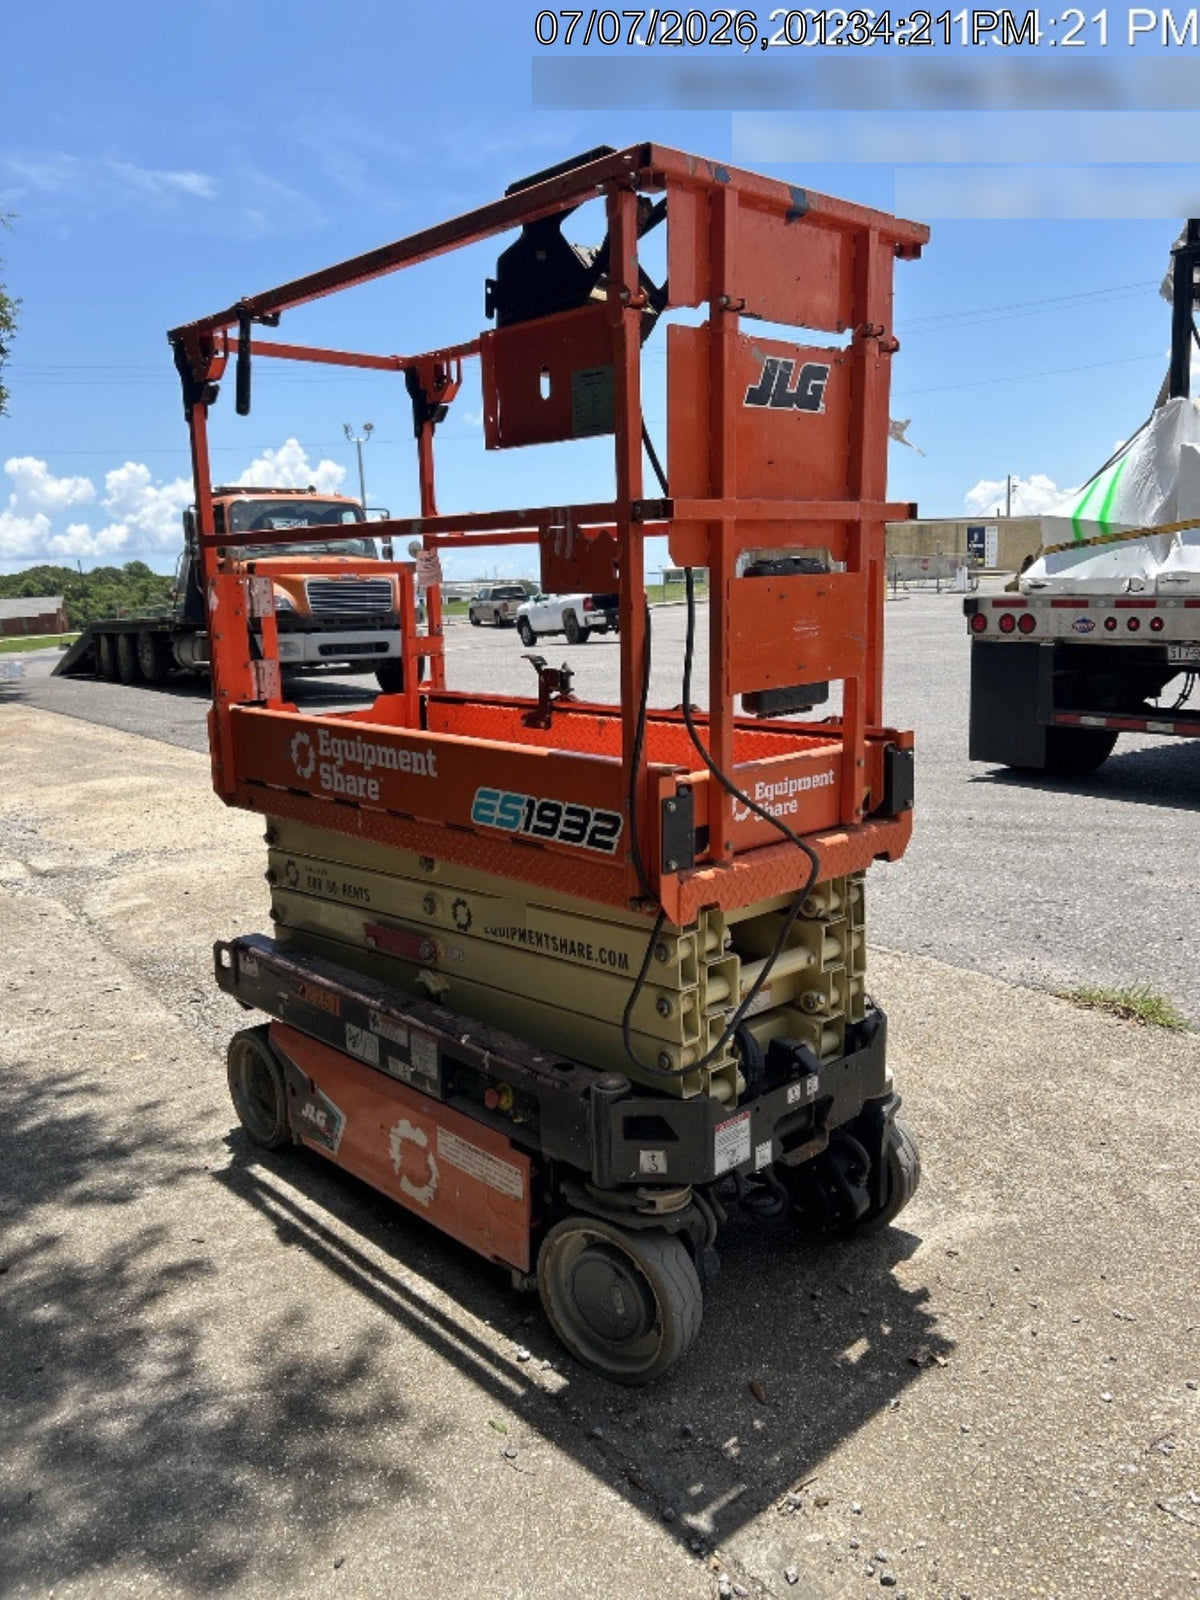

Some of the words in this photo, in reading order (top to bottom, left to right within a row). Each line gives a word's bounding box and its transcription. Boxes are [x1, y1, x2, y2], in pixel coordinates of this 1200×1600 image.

[743, 355, 831, 413] JLG
[316, 728, 438, 778] Equipment
[319, 762, 381, 801] Share
[755, 769, 835, 801] Equipment
[471, 787, 624, 855] ES1932
